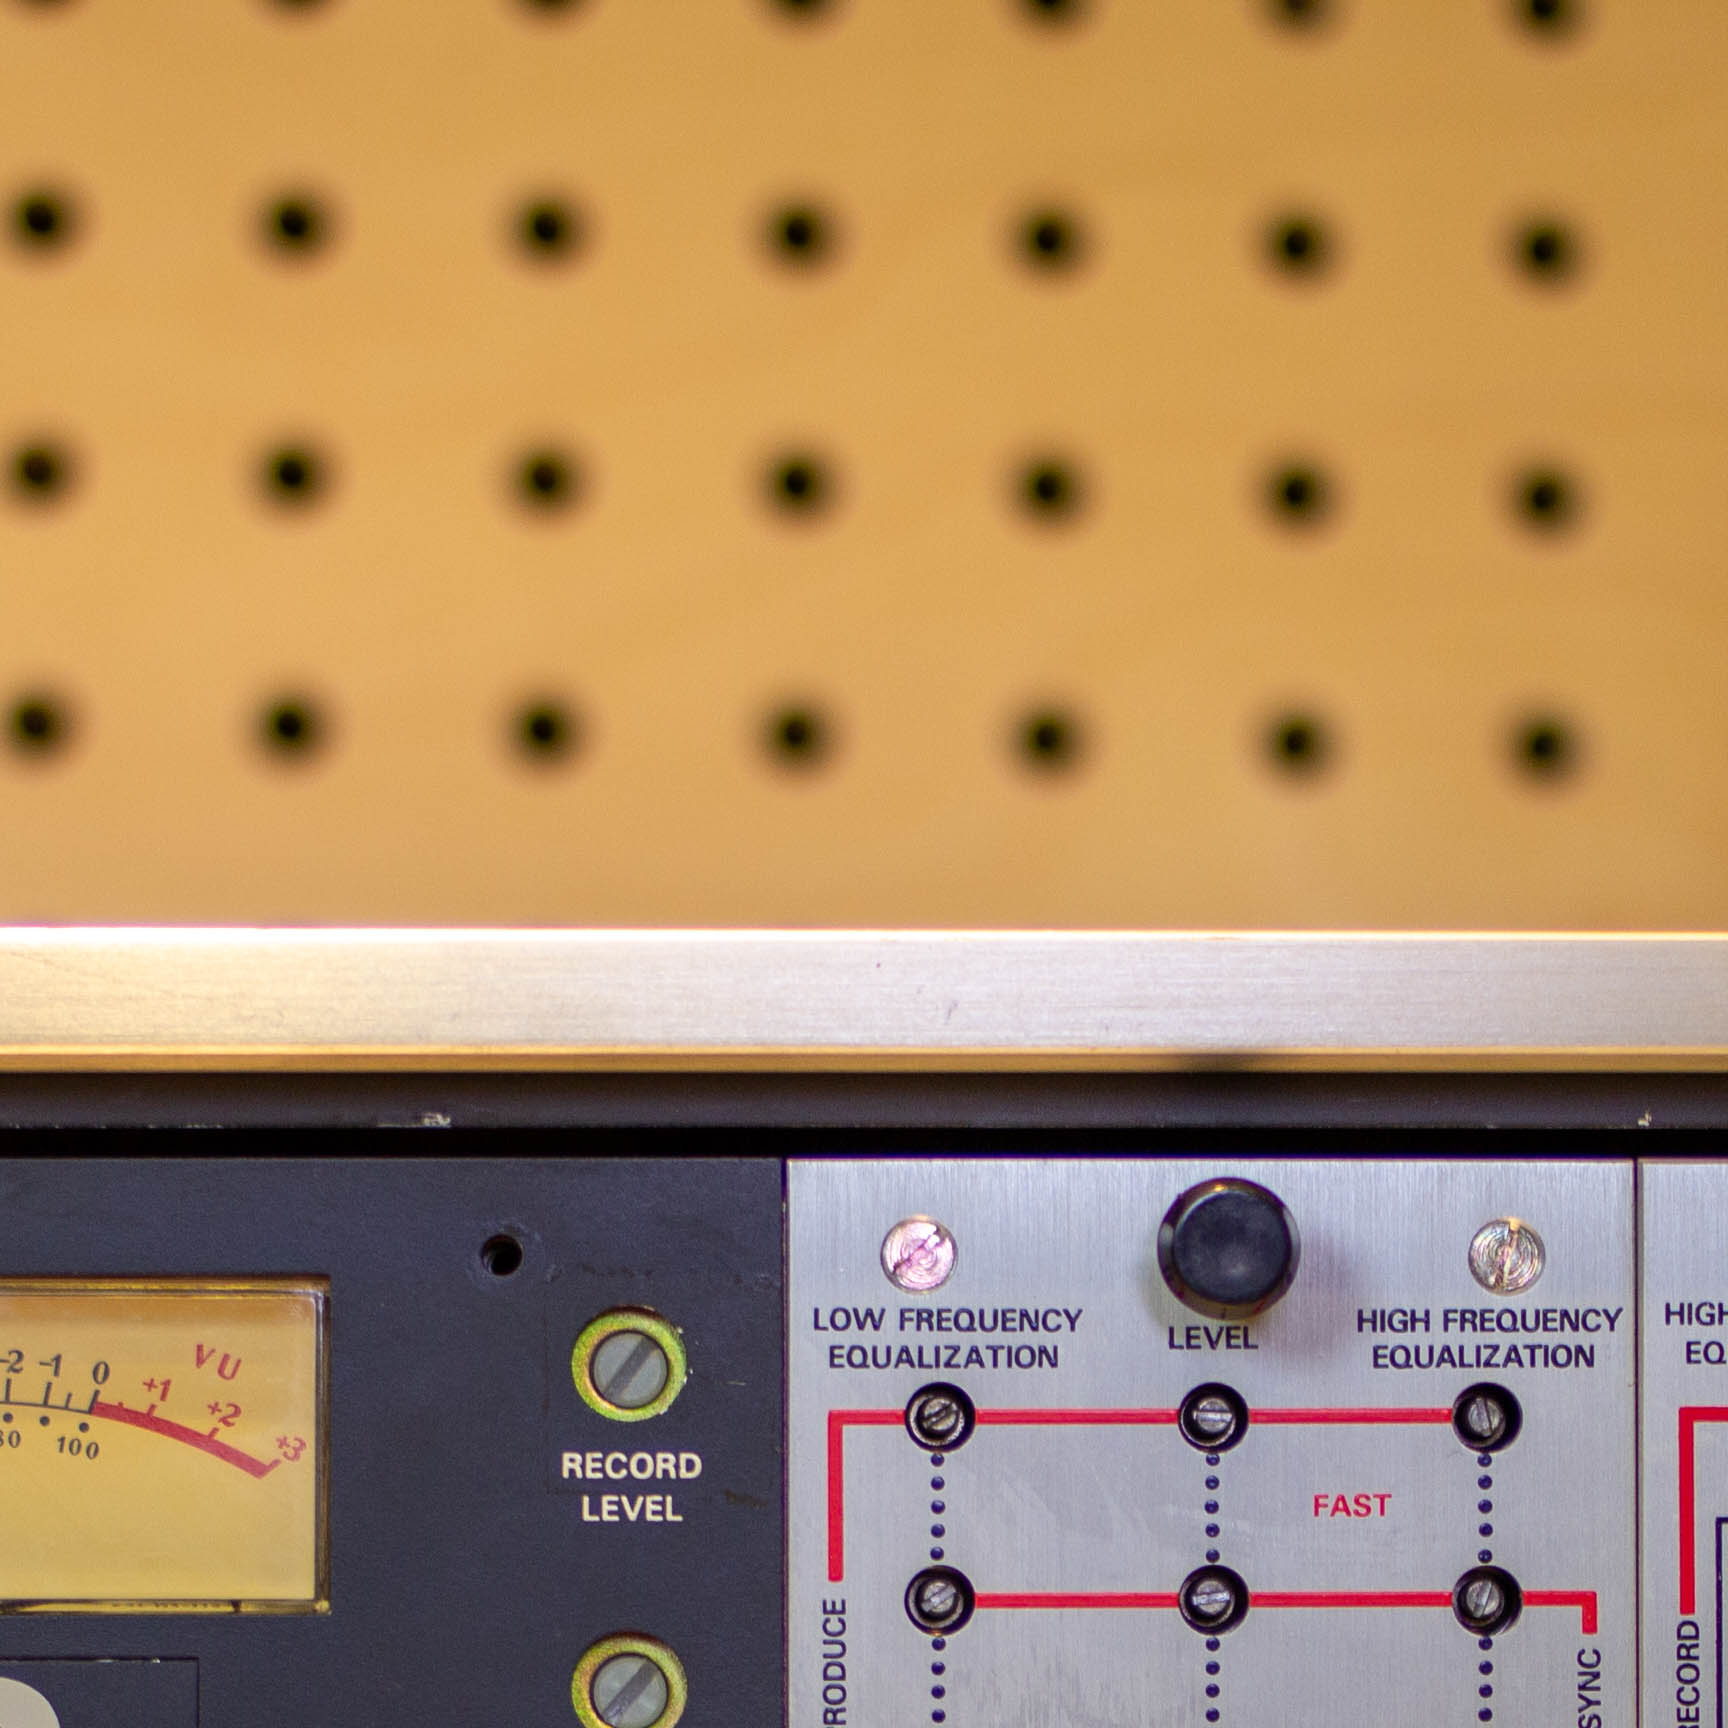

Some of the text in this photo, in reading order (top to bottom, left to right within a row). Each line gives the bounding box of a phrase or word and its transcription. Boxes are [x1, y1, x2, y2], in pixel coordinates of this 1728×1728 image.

[813, 1307, 1083, 1333] LOW FREQUENCY
[1356, 1307, 1623, 1334] HIGH FREQUENCY
[1168, 1326, 1258, 1350] LEVEL
[195, 1343, 242, 1381] VU
[829, 1344, 1059, 1370] EQUALIZATION
[1372, 1343, 1595, 1370] EQUALIZATION
[92, 1361, 110, 1385] 0
[57, 1436, 100, 1460] 100
[562, 1451, 703, 1480] RECORD
[582, 1494, 683, 1522] LEVEL
[1313, 1493, 1392, 1518] FAST
